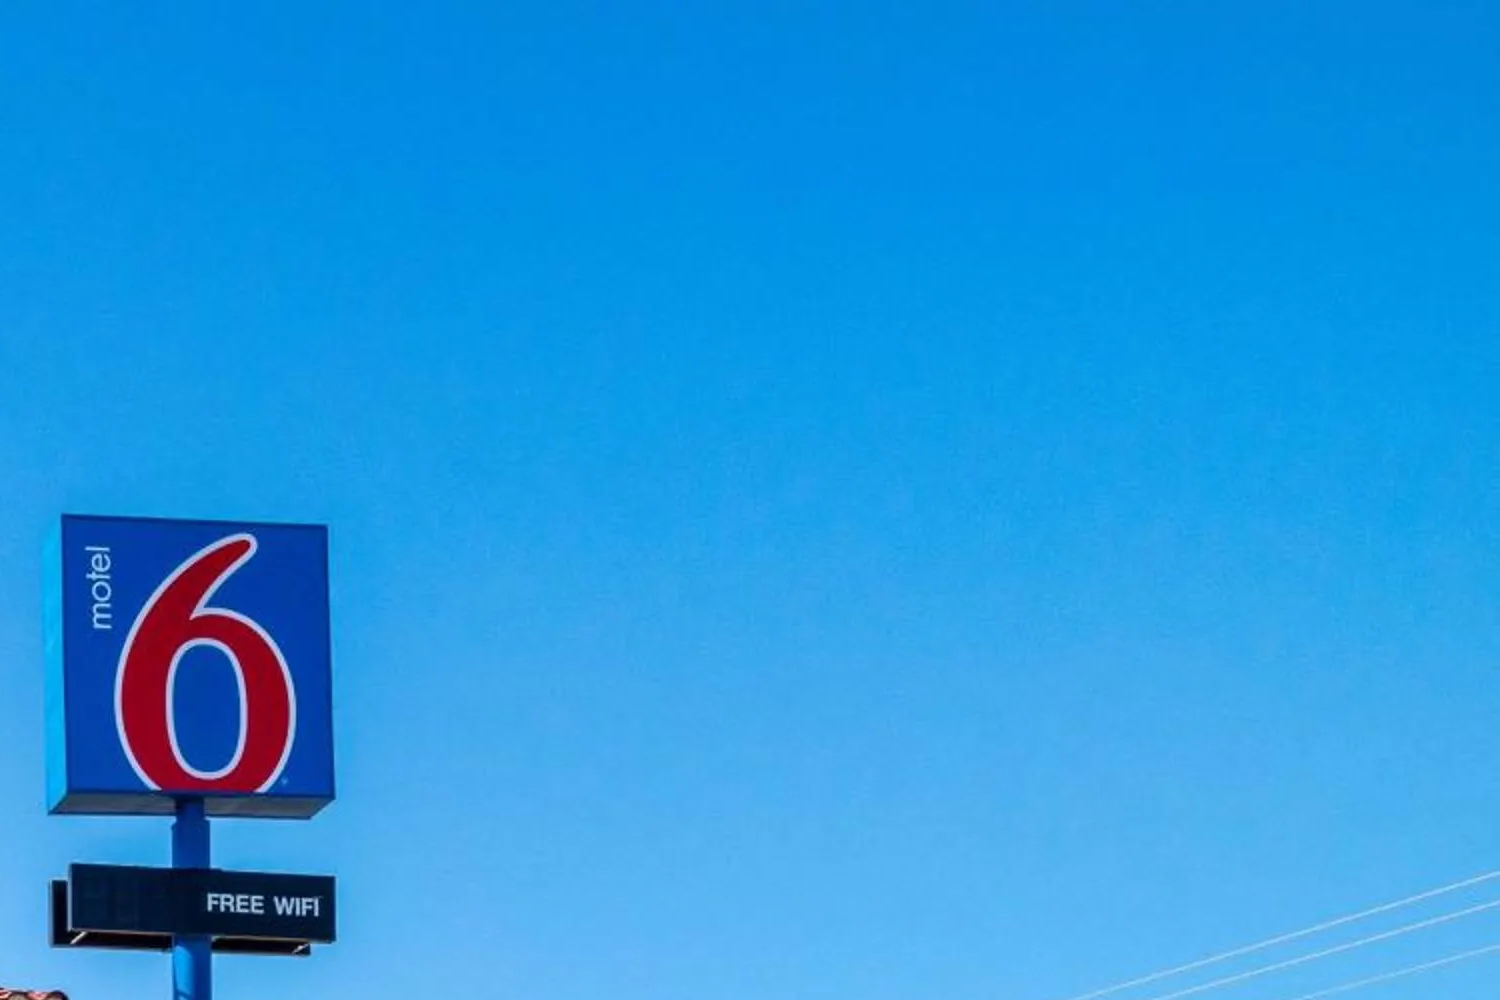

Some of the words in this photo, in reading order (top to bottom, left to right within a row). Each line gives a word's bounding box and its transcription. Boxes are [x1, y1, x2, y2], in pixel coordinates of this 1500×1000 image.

[84, 545, 112, 630] motel
[113, 532, 297, 794] 6
[206, 892, 265, 915] FREE
[273, 896, 321, 917] WIFI
